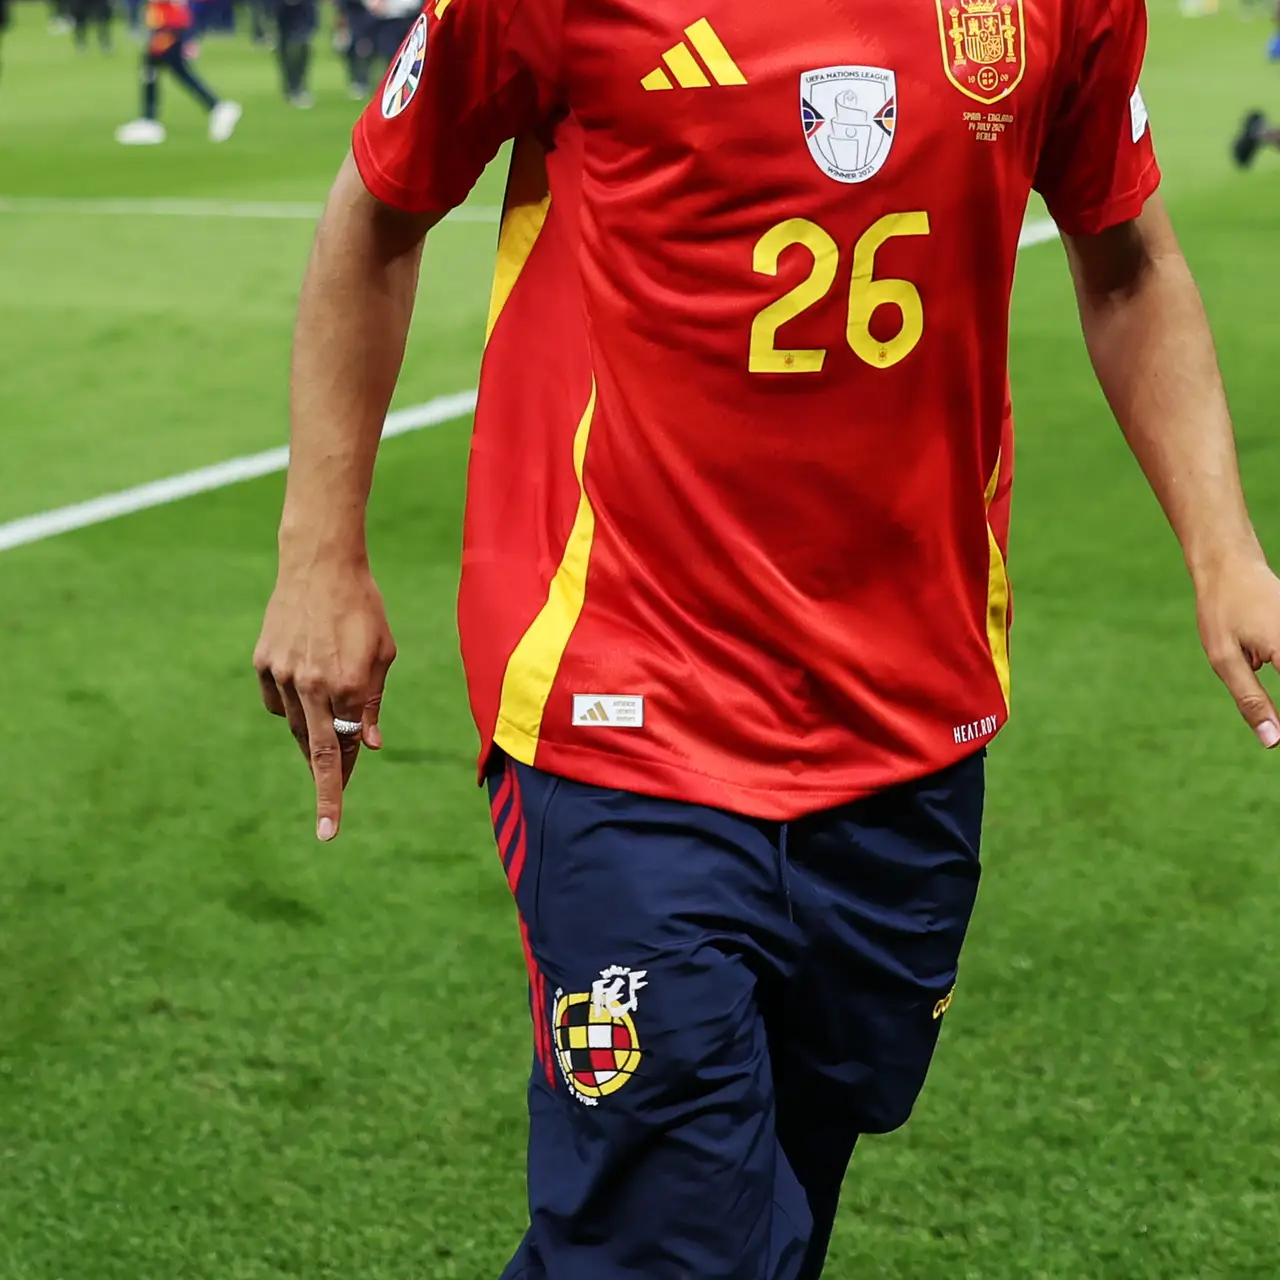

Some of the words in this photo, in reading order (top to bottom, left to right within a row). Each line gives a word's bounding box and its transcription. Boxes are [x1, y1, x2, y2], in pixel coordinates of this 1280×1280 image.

[806, 74, 825, 83] UEFA
[826, 70, 860, 80] NATIONS
[861, 72, 890, 82] LEAGUE
[962, 111, 981, 121] SPAIN
[987, 113, 1014, 123] ENGLAND
[827, 166, 857, 180] WINNER
[858, 165, 875, 178] 2023
[748, 210, 930, 373] 26
[953, 714, 997, 744] HEAT.RDY
